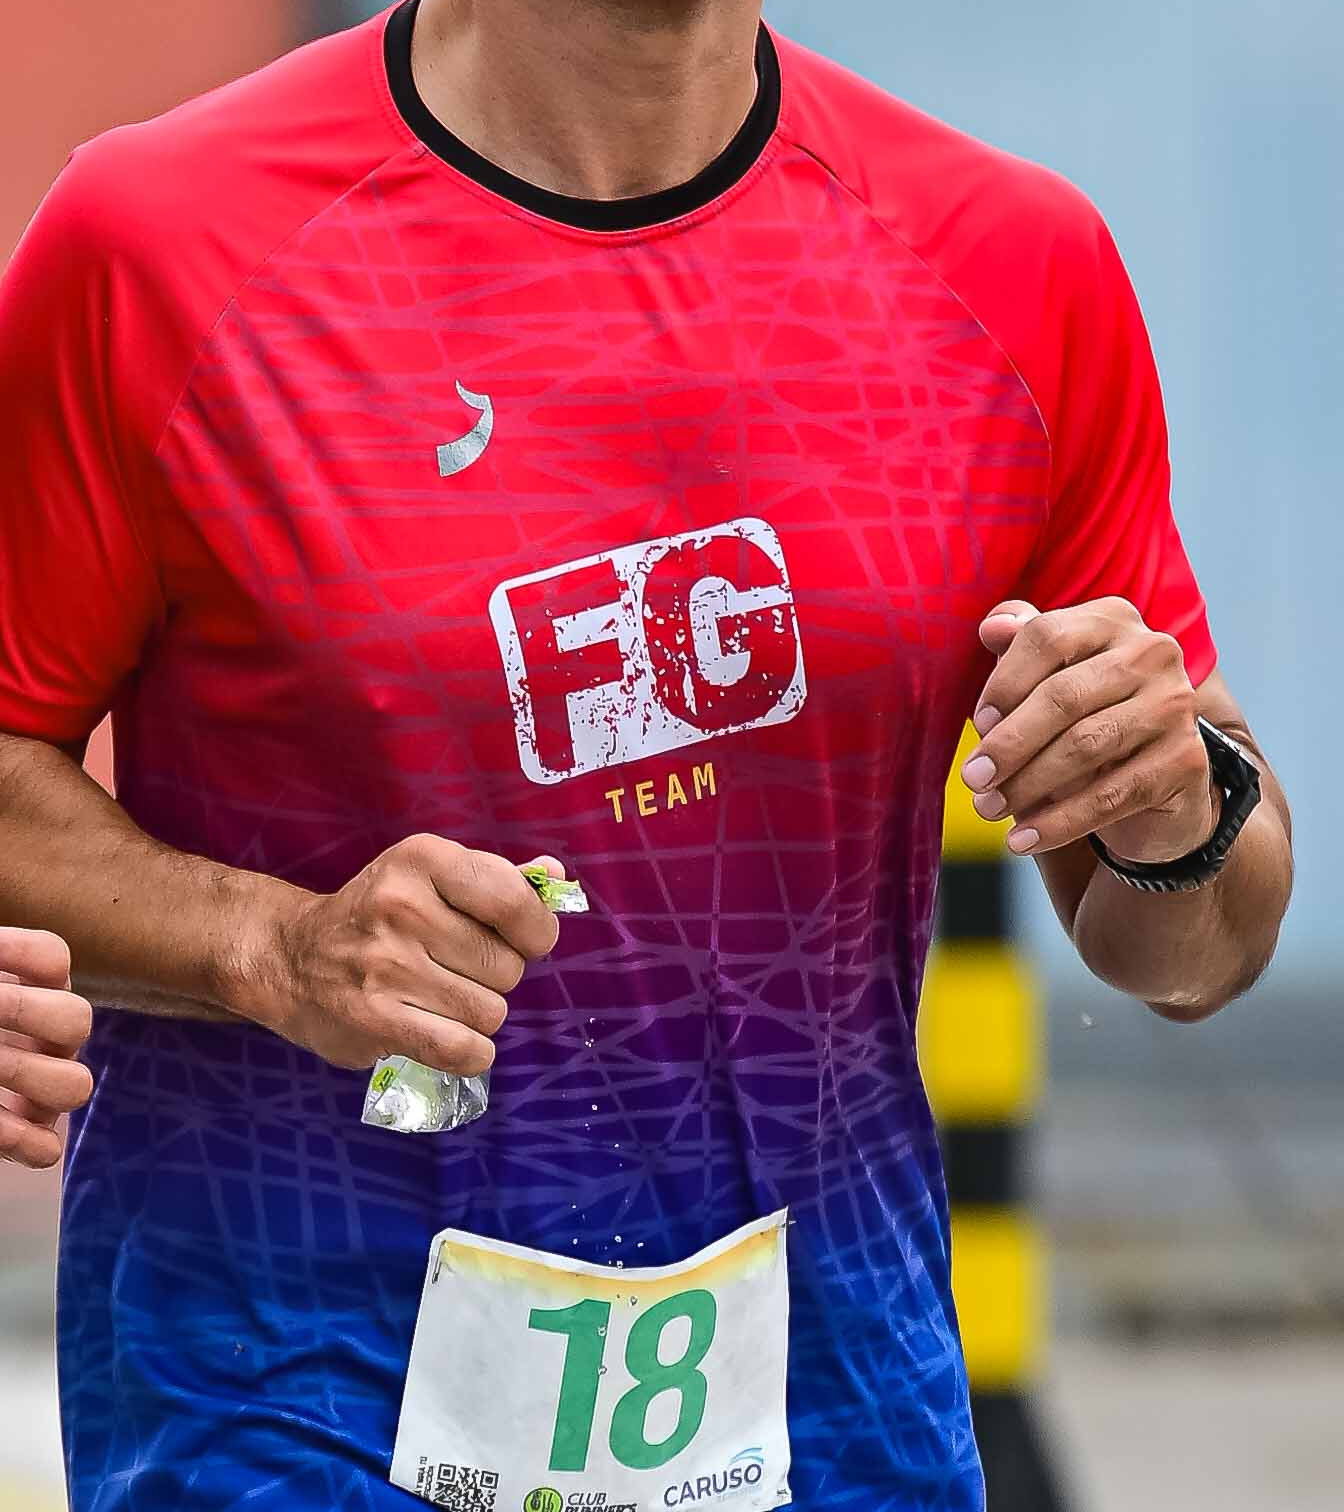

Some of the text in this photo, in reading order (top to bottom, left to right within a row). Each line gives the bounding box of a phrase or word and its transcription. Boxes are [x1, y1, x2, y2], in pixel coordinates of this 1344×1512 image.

[500, 528, 800, 774] FG
[605, 761, 720, 824] TEAM
[527, 1288, 718, 1473] 18
[567, 1492, 607, 1506] CLUB
[663, 1463, 762, 1507] CARUSO
